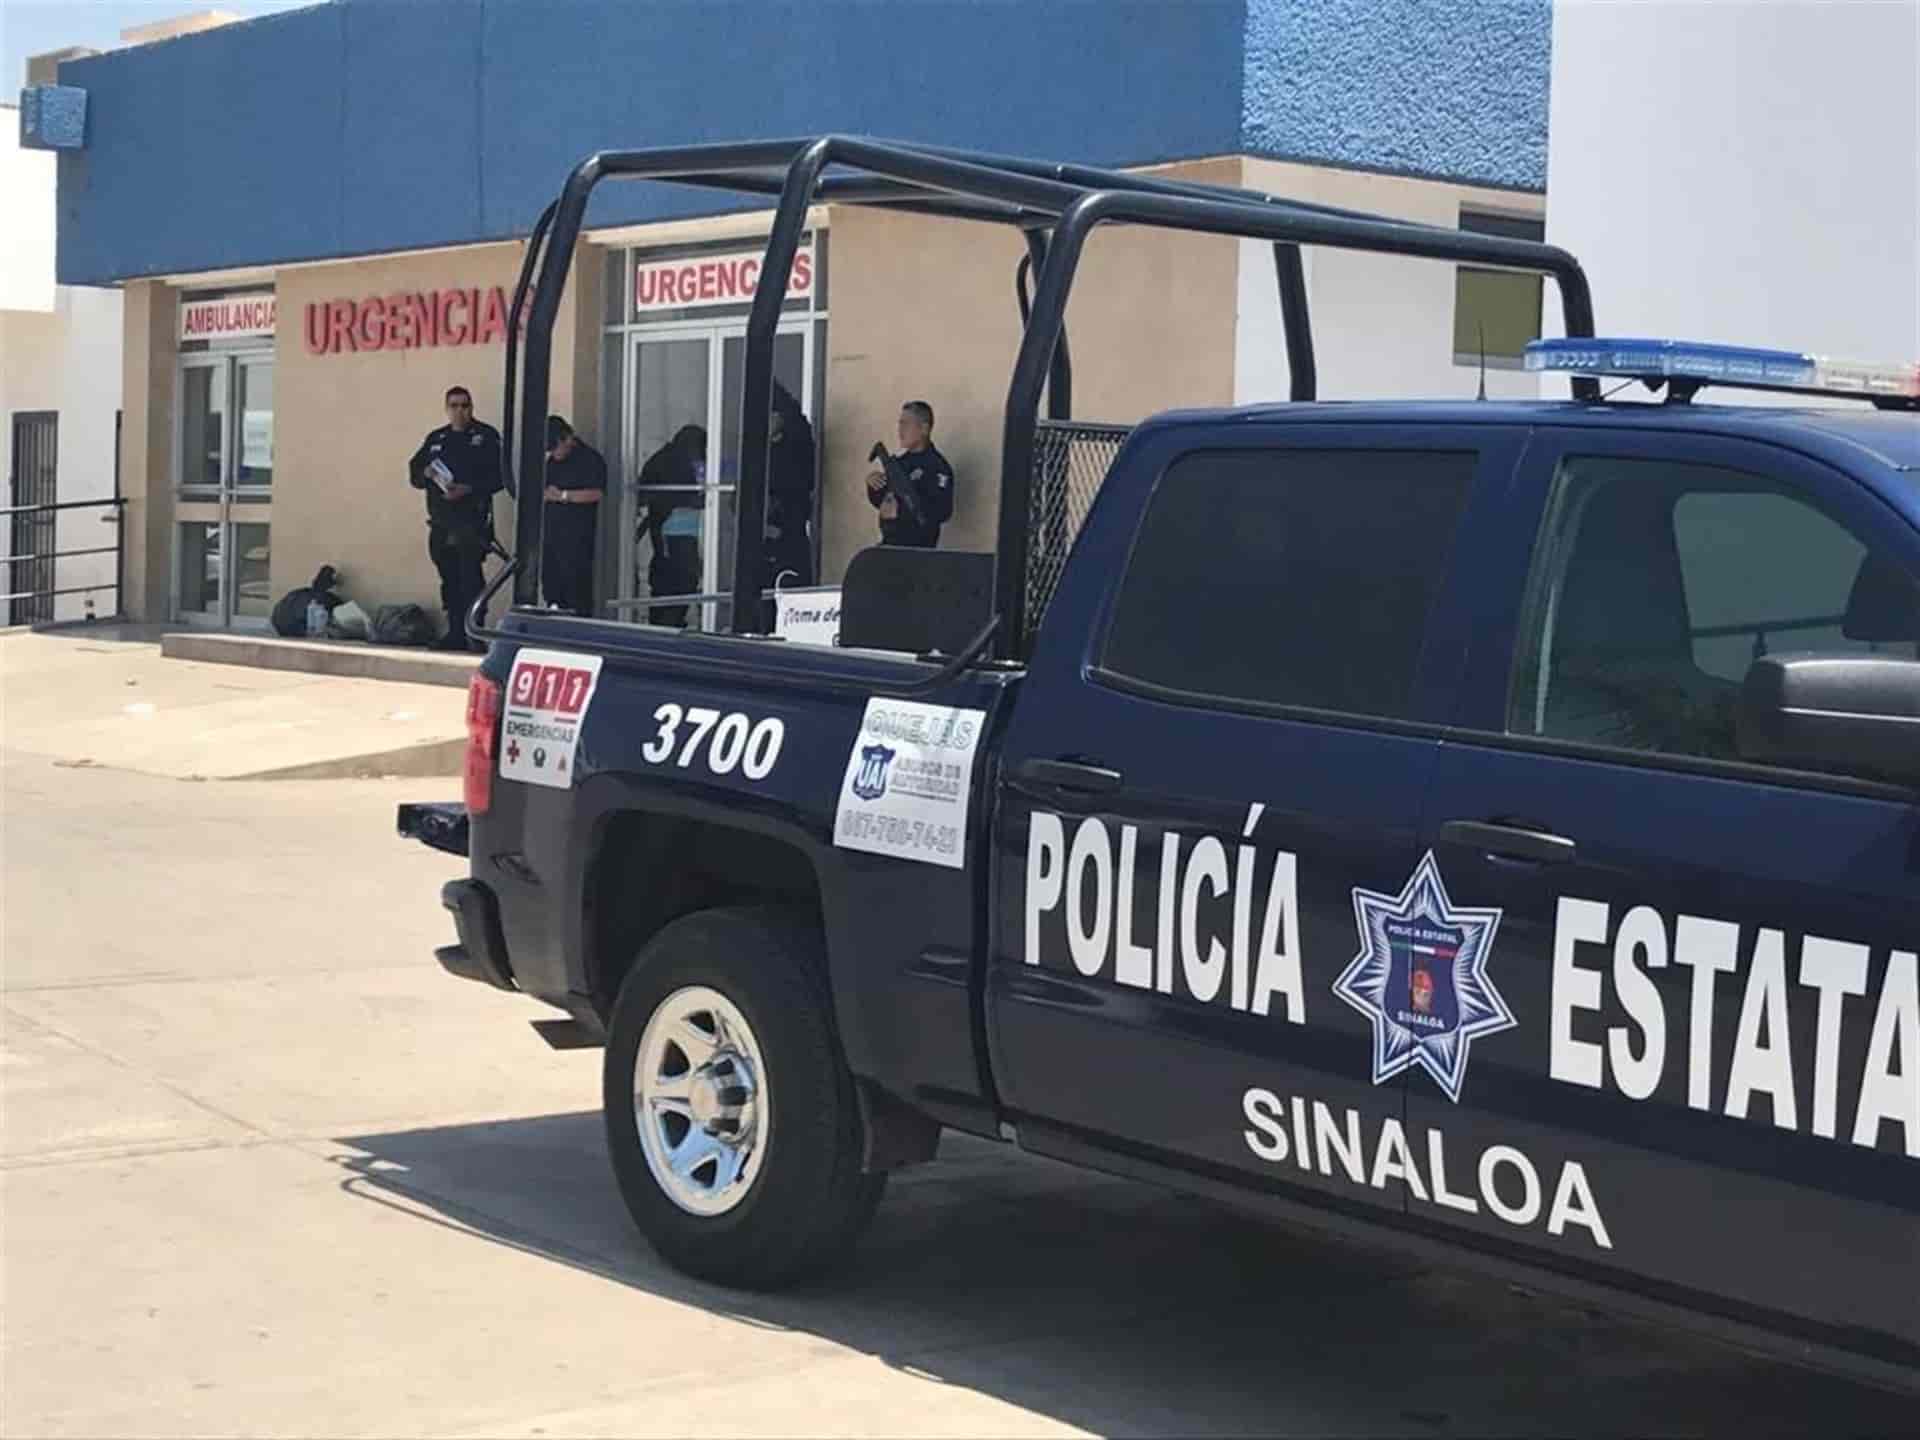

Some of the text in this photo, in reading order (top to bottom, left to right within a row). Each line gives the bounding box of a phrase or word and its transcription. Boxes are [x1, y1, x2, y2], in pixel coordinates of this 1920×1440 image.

[638, 254, 811, 304] URGENCS
[304, 286, 533, 355] URGENCIA
[516, 671, 583, 707] 911
[642, 703, 784, 780] 3700
[867, 710, 975, 750] QUEJAS
[1024, 803, 1306, 1025] POLICÍA
[1397, 1010, 1445, 1030] SINALOA
[1550, 896, 1920, 1159] ESTATA
[1243, 1088, 1613, 1250] SINALOA
